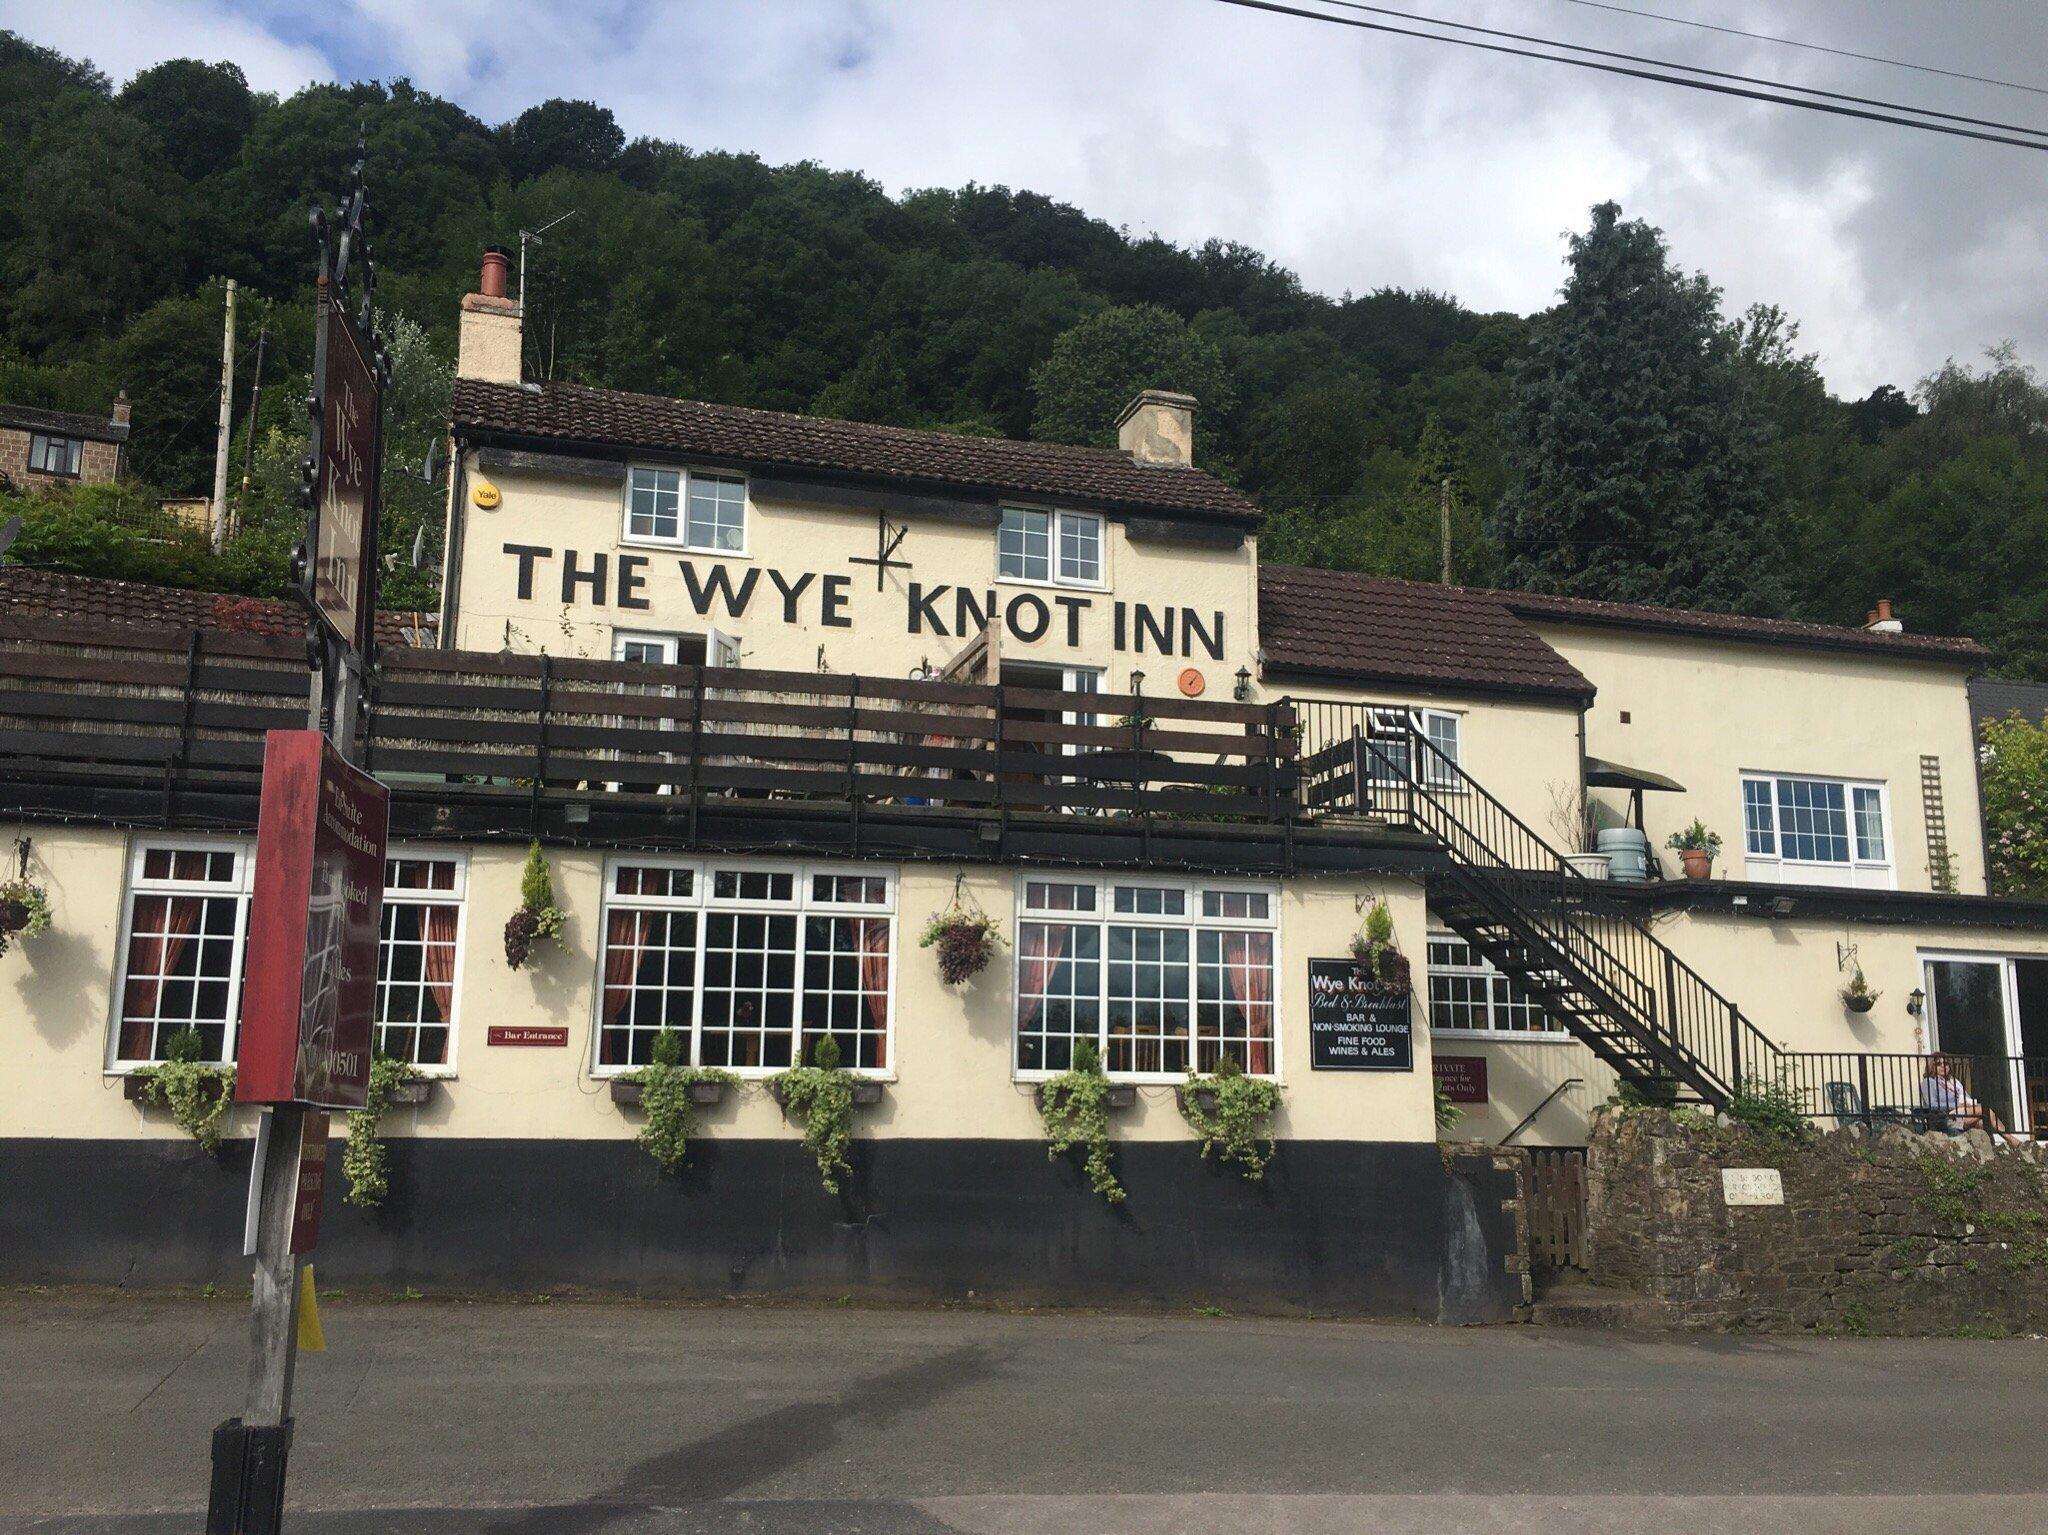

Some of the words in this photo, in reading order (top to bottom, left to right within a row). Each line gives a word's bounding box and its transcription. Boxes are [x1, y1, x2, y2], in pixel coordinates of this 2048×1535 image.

[344, 378, 359, 427] The
[335, 398, 362, 487] Wye
[478, 489, 497, 500] Yale
[325, 456, 361, 553] Knot
[325, 525, 357, 616] Inn
[503, 543, 650, 610] THE
[679, 561, 852, 627] WYE
[908, 582, 1091, 647] KNOT
[1114, 601, 1224, 661] INN
[1351, 967, 1368, 976] THE
[1312, 975, 1343, 993] Wye
[1348, 976, 1380, 991] Knot
[1311, 992, 1339, 1009] Bed
[1352, 993, 1406, 1011] Breakfast
[1346, 1014, 1366, 1022] BAR
[1370, 1014, 1377, 1022] &
[1375, 1024, 1409, 1034] LOUNGE
[504, 1030, 521, 1039] Bar
[523, 1030, 563, 1040] Entrance
[1338, 1037, 1359, 1045] FINE
[1361, 1037, 1386, 1046] FOOD
[1329, 1047, 1359, 1055] WINES
[1361, 1047, 1368, 1056] &
[1371, 1047, 1395, 1056] ALES
[1433, 1063, 1466, 1073] RIVATE
